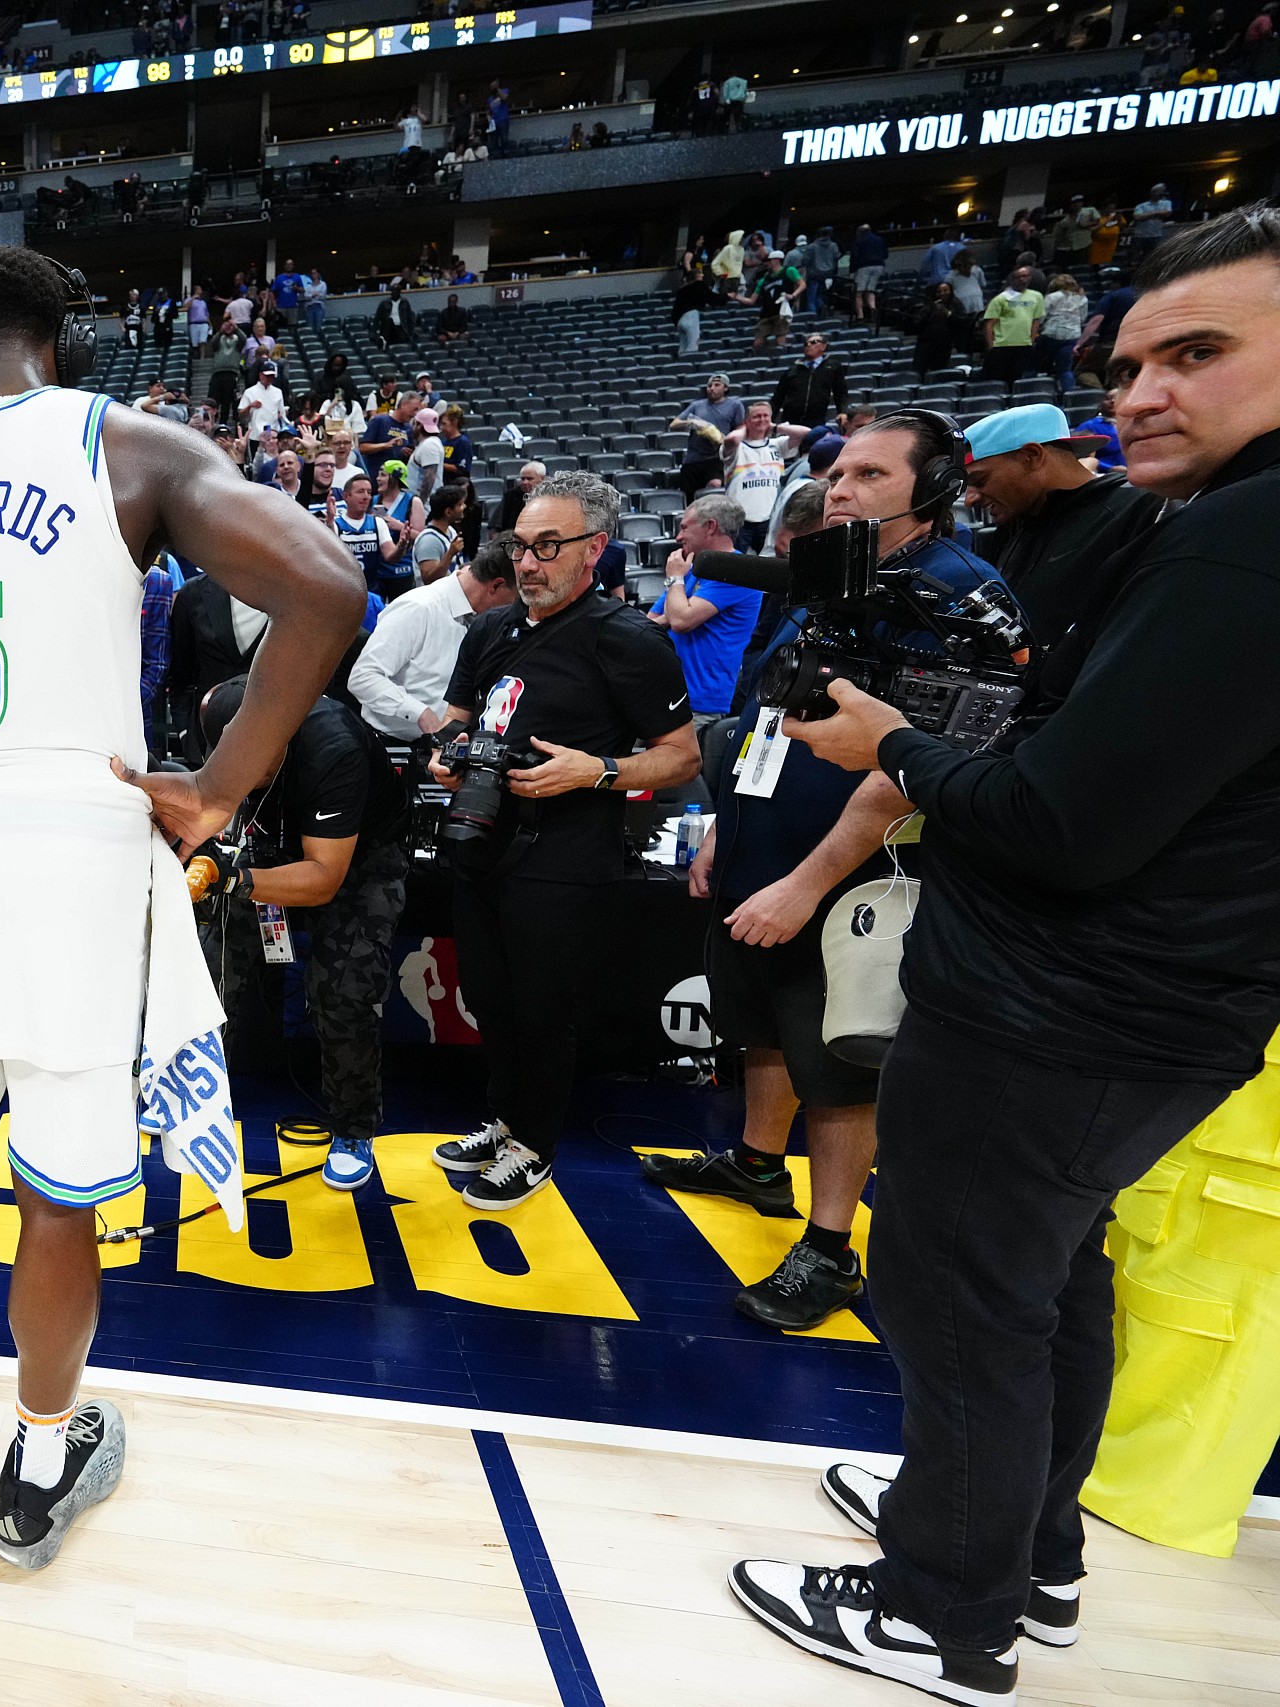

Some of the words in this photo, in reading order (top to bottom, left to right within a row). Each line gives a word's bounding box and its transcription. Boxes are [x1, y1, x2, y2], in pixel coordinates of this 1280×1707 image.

[381, 40, 391, 55] 5
[457, 30, 474, 46] 24
[496, 25, 513, 40] 41
[214, 46, 243, 67] 0.0
[289, 43, 314, 64] 90
[265, 56, 271, 70] 1
[147, 62, 170, 82] 98
[185, 66, 194, 80] 2
[970, 70, 997, 83] 234
[77, 79, 87, 94] 5
[782, 121, 890, 165] THANK
[979, 94, 1141, 146] NUGGETS
[1145, 79, 1280, 129] NATION
[500, 288, 520, 299] 126
[770, 451, 780, 461] 15
[977, 682, 1014, 694] SONY
